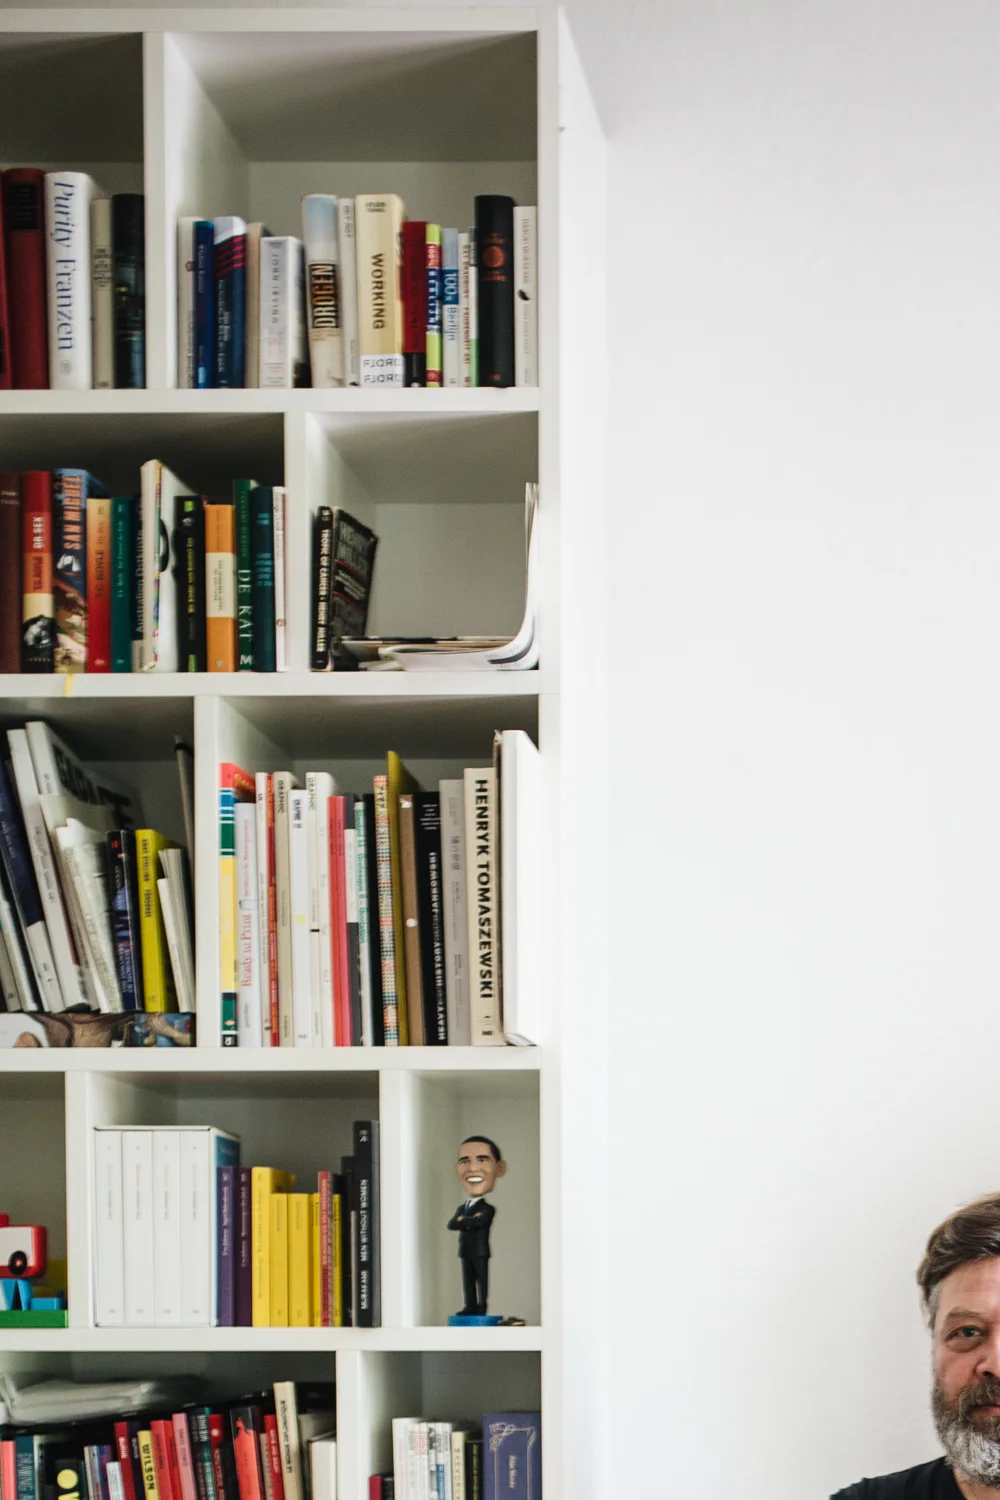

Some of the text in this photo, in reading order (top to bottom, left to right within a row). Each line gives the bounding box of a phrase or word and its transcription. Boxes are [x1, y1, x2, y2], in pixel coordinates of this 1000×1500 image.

[51, 181, 78, 351] Purity Franzen
[271, 253, 279, 324] JOHN IRVING
[311, 264, 338, 328] DROGEN
[370, 253, 386, 330] WORKING
[439, 308, 458, 341] Berlijn
[33, 516, 43, 534] SEX
[61, 475, 81, 550] SAN MIGUEL
[320, 529, 330, 555] TROPIC
[320, 556, 330, 566] OF
[318, 568, 328, 596] CANCER
[238, 569, 252, 642] DE KAT
[316, 626, 327, 652] MILLER
[277, 779, 285, 814] GRAPHIC
[475, 779, 495, 999] HENRYK TOMASZEWSKI
[241, 914, 252, 940] Print
[241, 958, 252, 988] Ready
[360, 1179, 368, 1208] WOMEN
[360, 1210, 368, 1243] WITHOUT
[142, 1444, 155, 1491] WILSON
